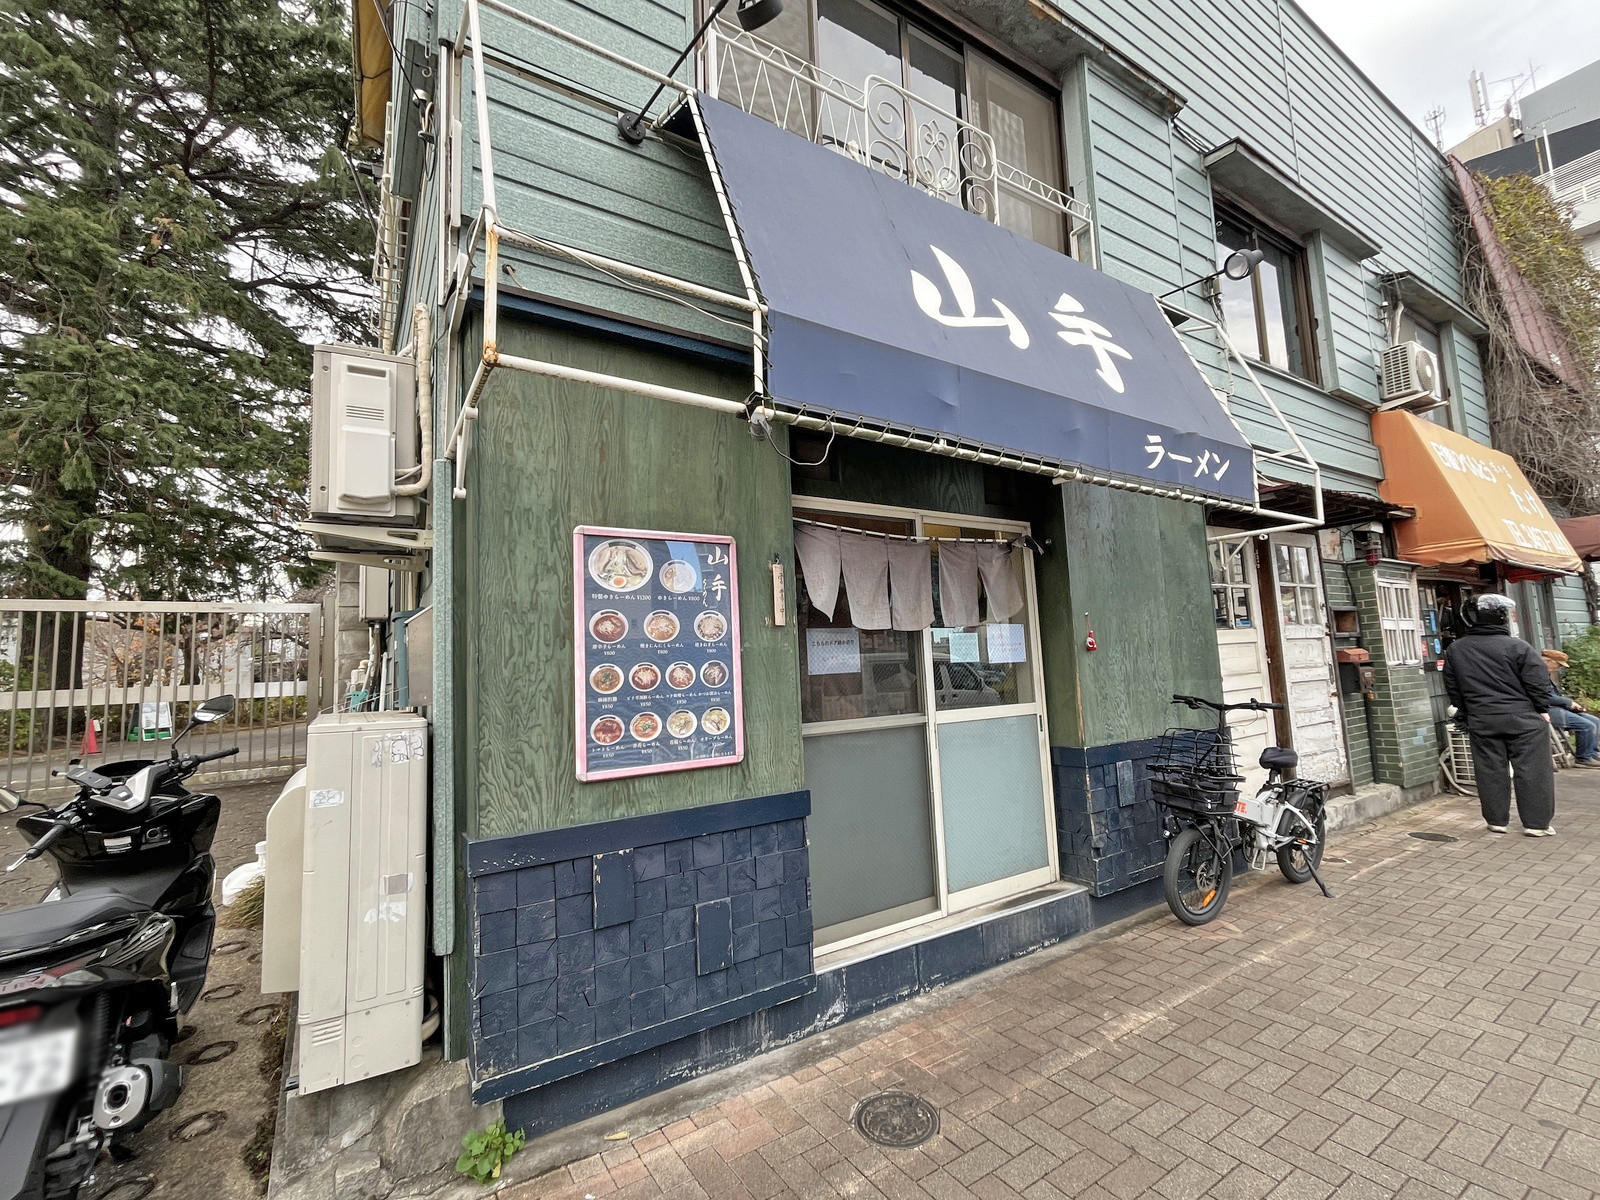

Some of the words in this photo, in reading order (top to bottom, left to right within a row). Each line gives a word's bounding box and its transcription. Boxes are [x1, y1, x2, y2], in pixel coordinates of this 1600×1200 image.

[909, 243, 1133, 394] 山手
[1144, 434, 1230, 483] ラーメン
[707, 546, 728, 602] 山手
